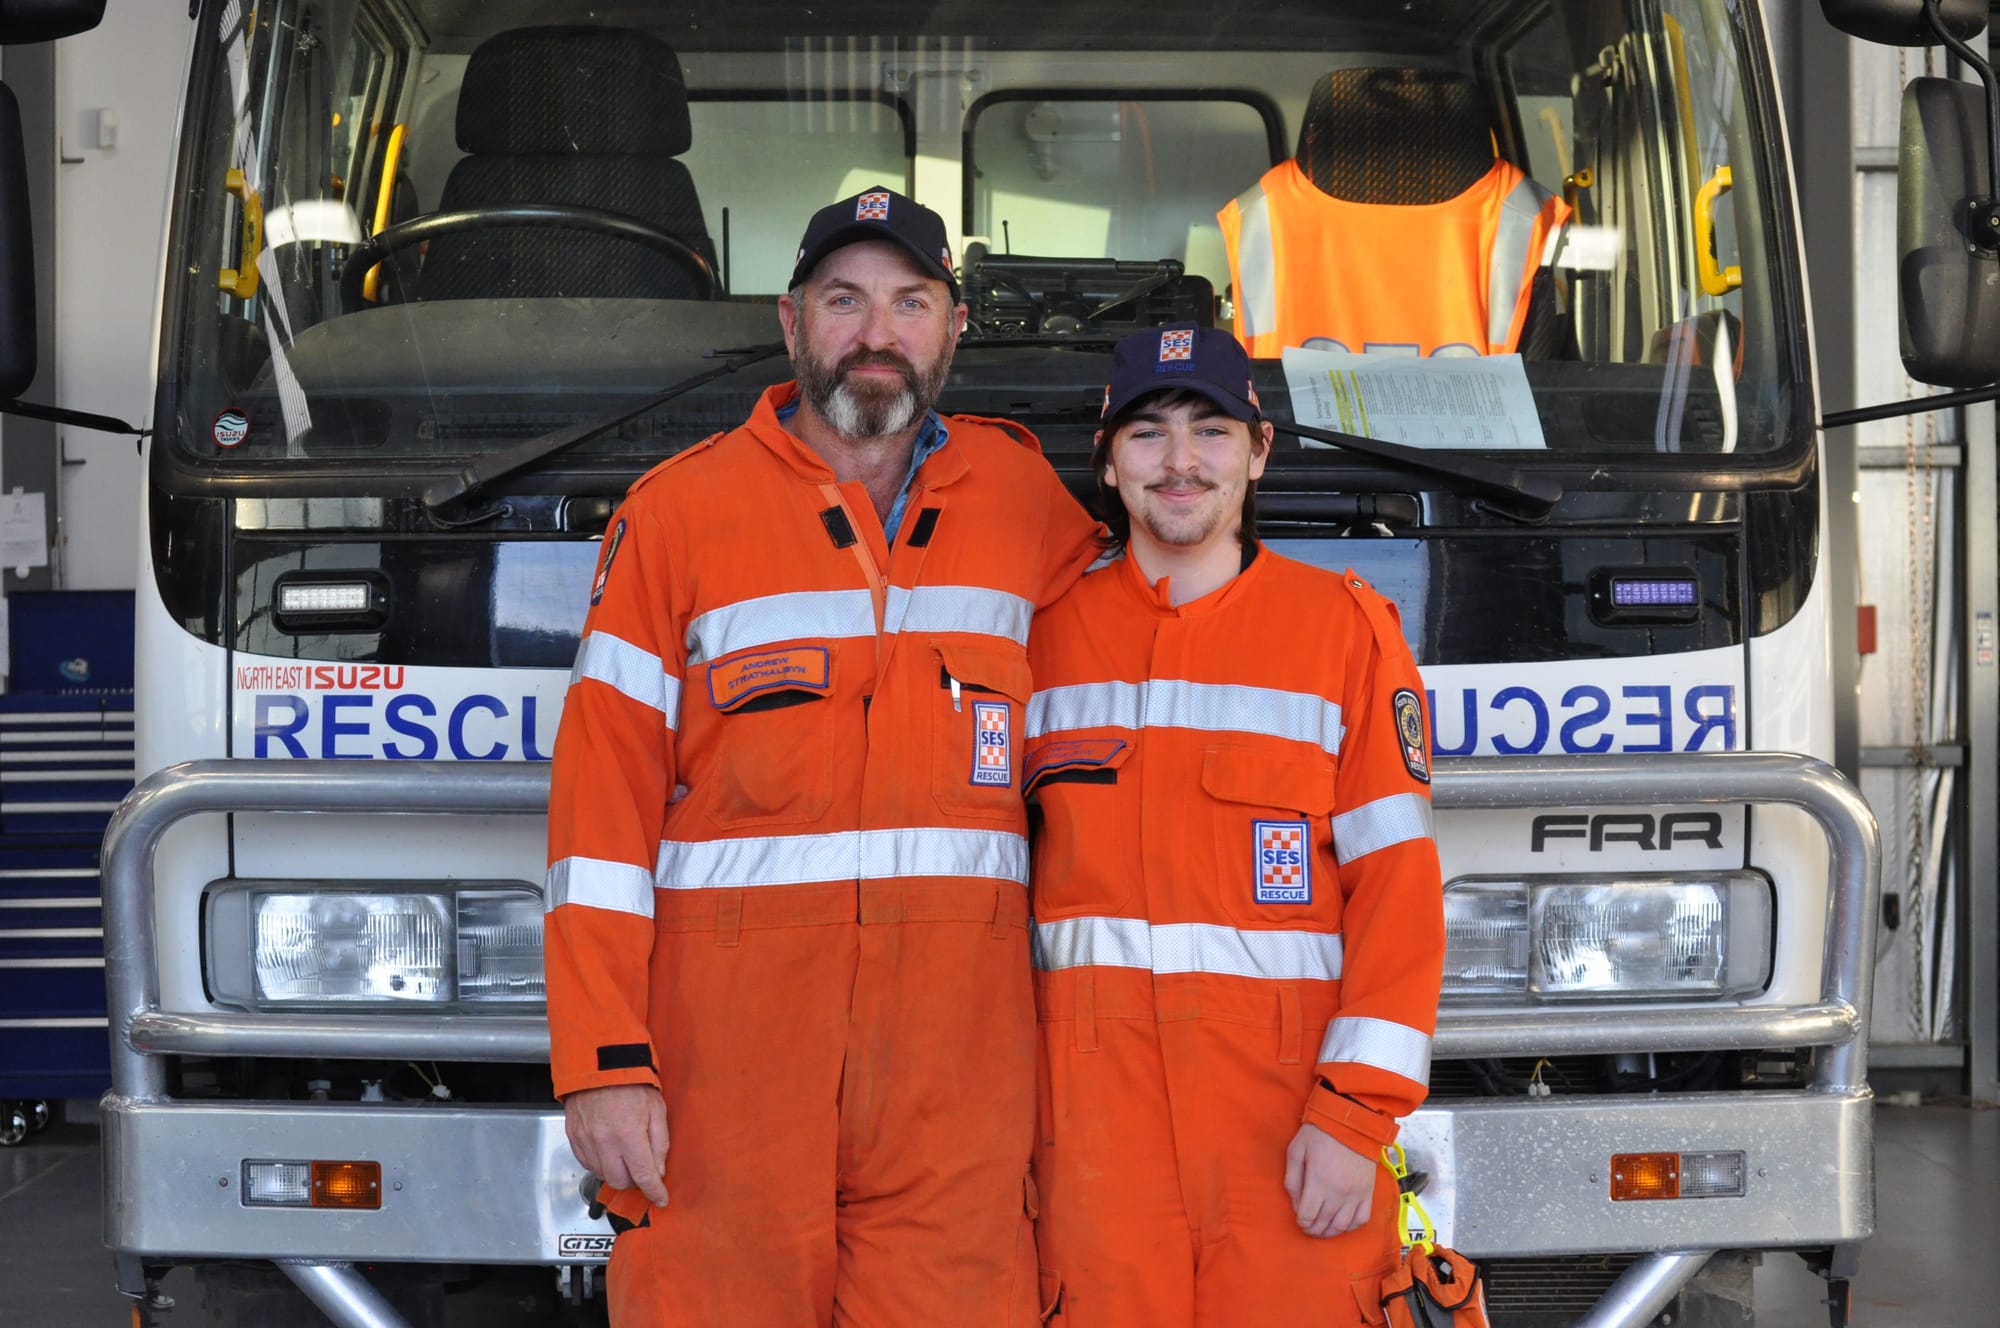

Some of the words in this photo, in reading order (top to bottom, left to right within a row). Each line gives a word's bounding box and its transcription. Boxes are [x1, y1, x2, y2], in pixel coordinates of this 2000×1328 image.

[1163, 339, 1190, 348] SES
[237, 666, 273, 690] NORTH
[275, 666, 303, 690] EAST
[305, 666, 405, 690] ISUZU
[254, 693, 567, 760] RESCU
[981, 731, 1005, 746] SES
[976, 771, 1008, 782] RESCUE
[1531, 812, 1724, 852] FRR
[1263, 849, 1300, 865] SES
[1260, 890, 1305, 899] RESCUE
